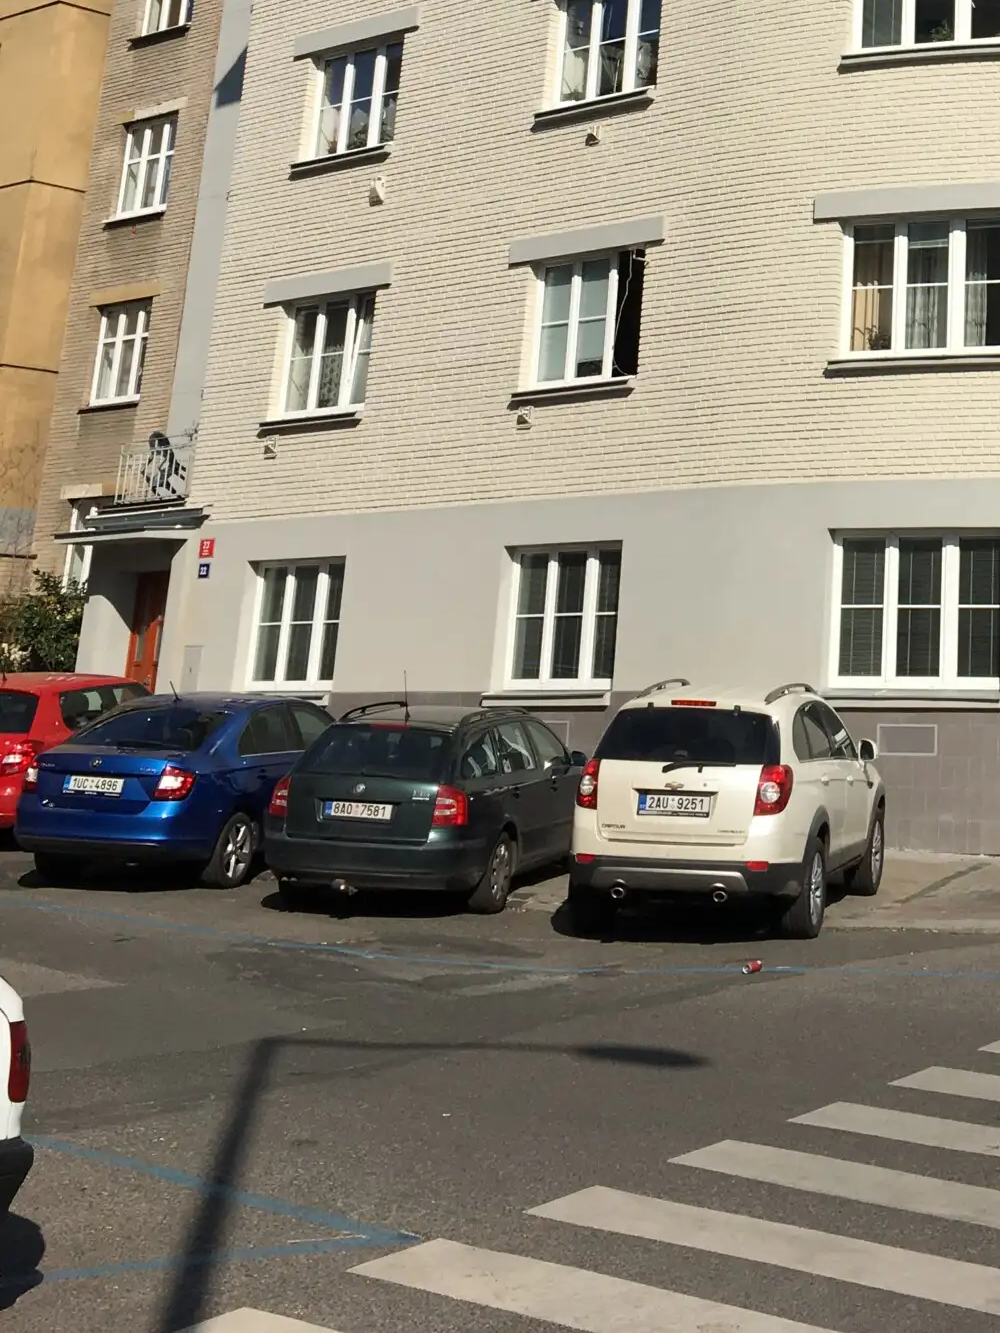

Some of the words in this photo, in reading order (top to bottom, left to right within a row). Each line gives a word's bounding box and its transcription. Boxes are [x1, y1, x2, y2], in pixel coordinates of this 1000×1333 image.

[73, 777, 90, 789] 1UC
[94, 780, 119, 791] 4896
[360, 804, 387, 817] 7581
[648, 796, 669, 809] 2AU
[676, 797, 704, 811] 9251
